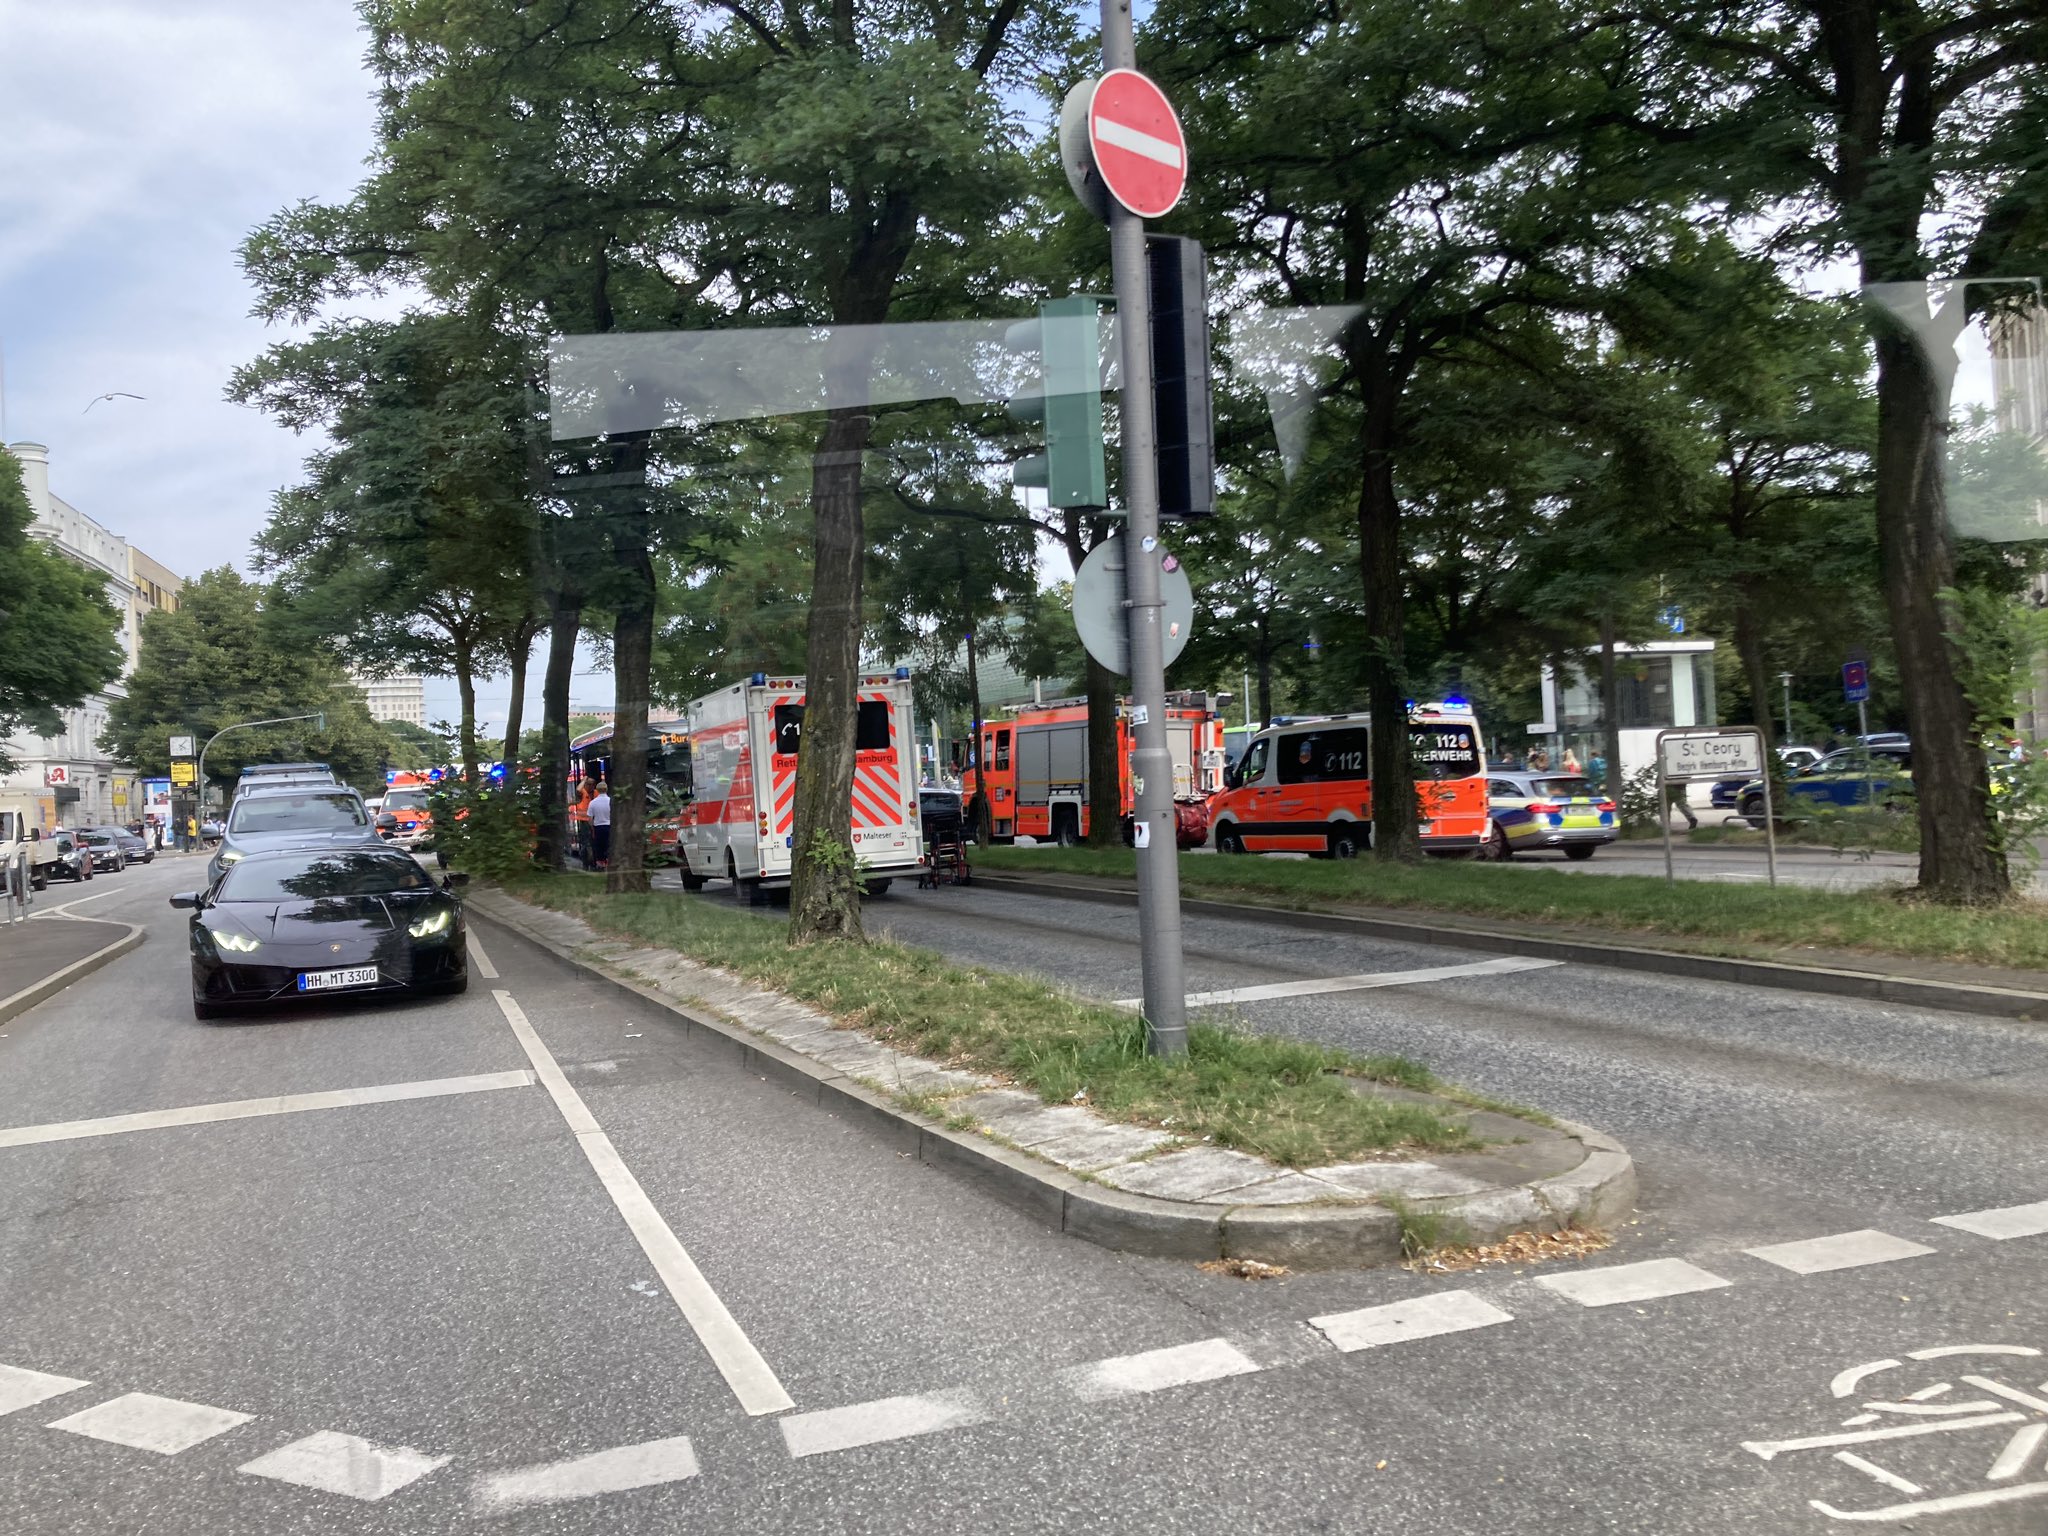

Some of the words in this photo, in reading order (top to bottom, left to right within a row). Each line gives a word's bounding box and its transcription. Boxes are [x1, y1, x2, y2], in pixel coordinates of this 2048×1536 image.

[1436, 734, 1459, 748] 112
[777, 758, 798, 769] Rett
[856, 755, 893, 764] amburg
[1339, 751, 1362, 770] 112
[863, 832, 893, 841] Malteser
[307, 974, 323, 988] HH
[330, 972, 345, 985] MT
[348, 969, 377, 983] 3300
